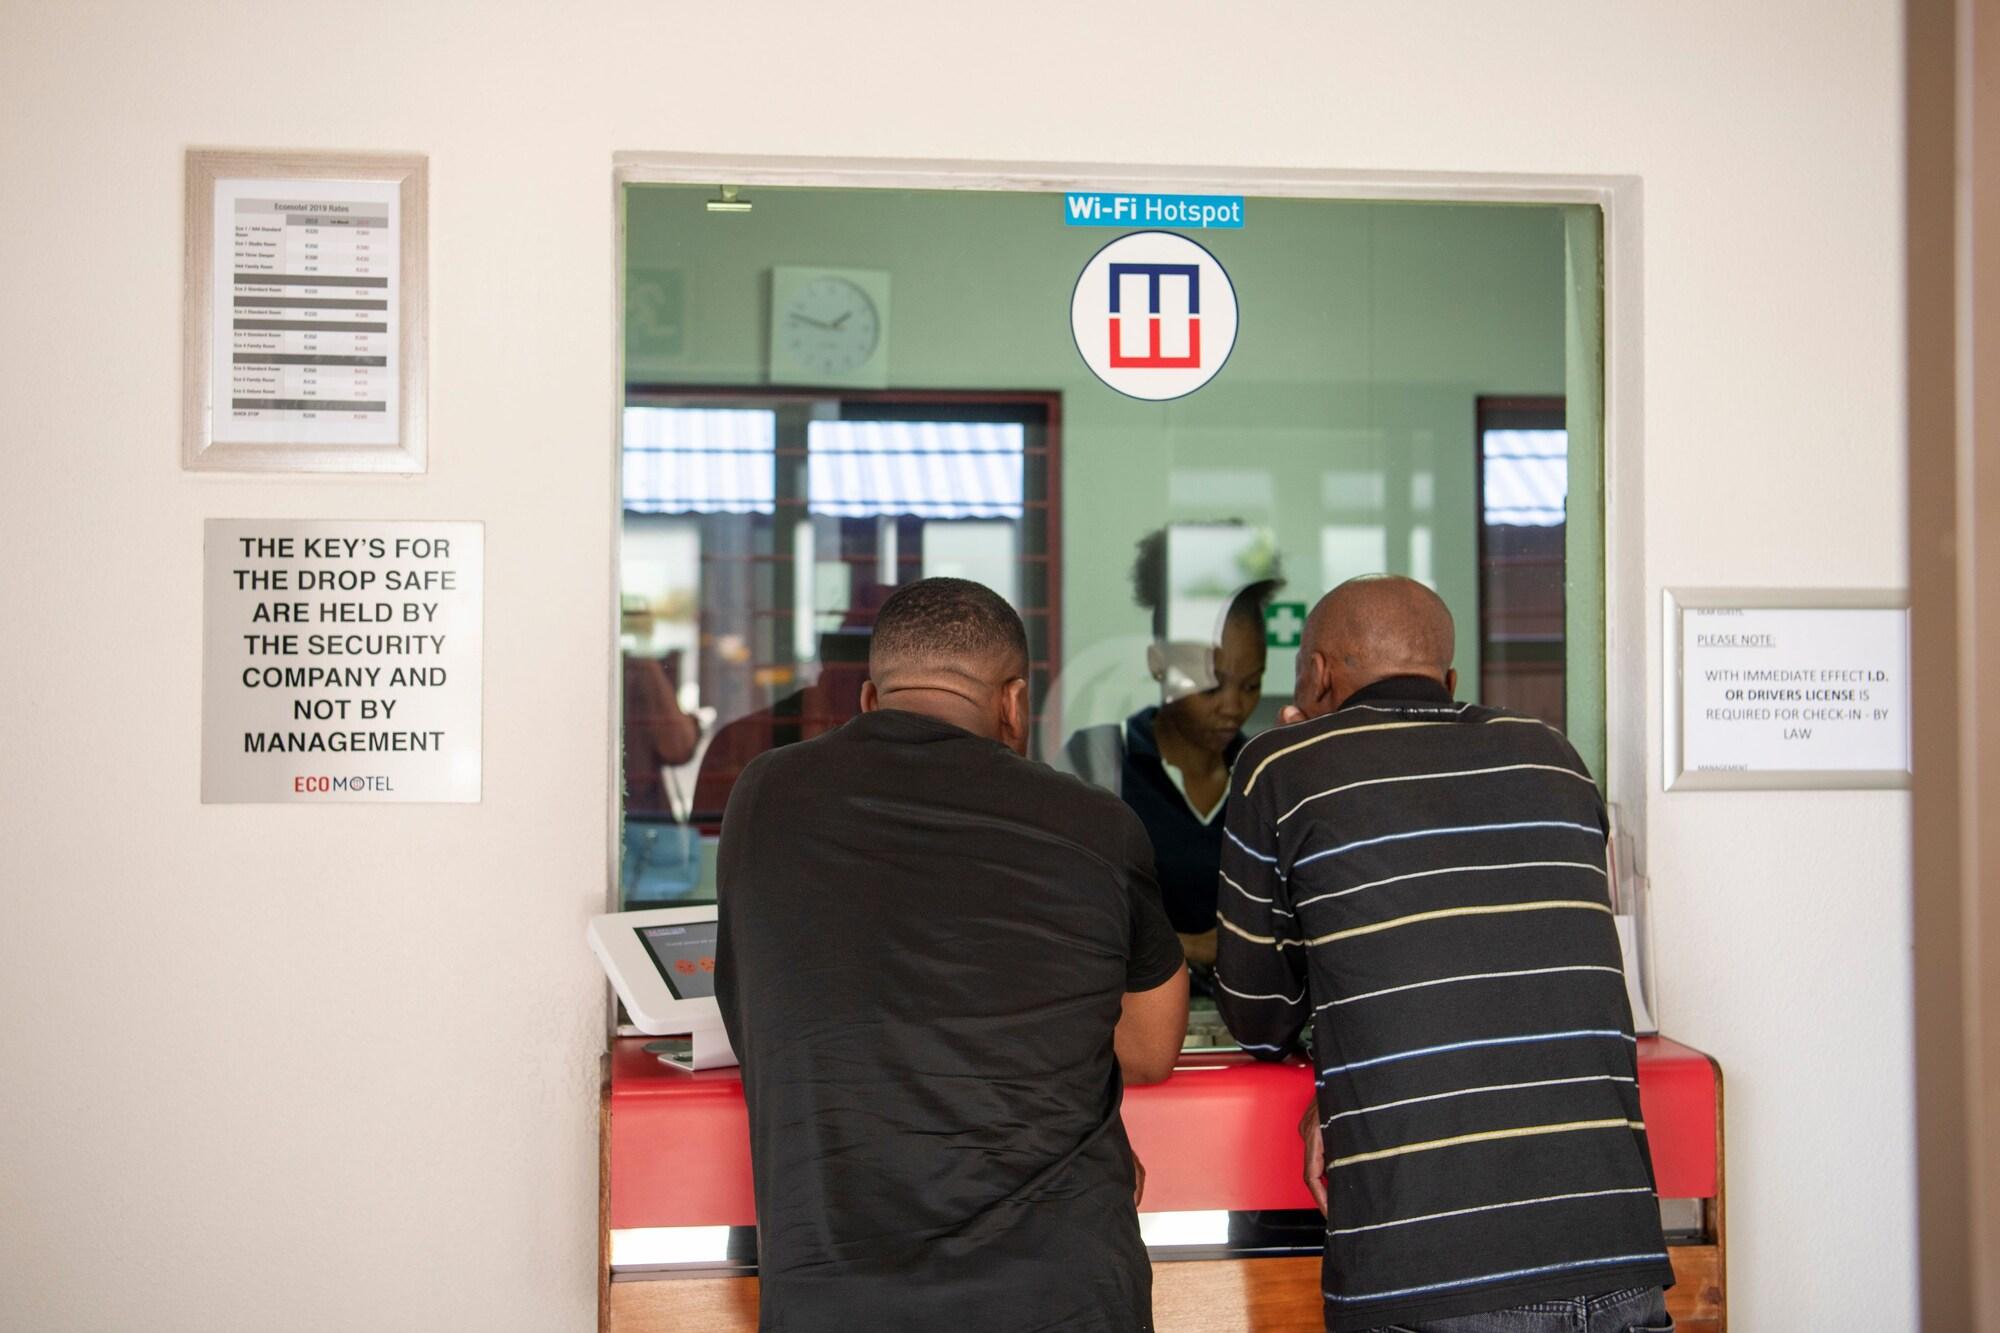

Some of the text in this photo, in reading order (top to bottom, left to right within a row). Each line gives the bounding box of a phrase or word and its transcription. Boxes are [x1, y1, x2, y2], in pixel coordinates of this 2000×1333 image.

[274, 202, 349, 213] Ecomotel 2019 Rates
[1068, 196, 1240, 228] Wi-Fi Hotspot
[239, 537, 451, 559] THE KEY'S FOR
[233, 570, 456, 591] THE DROP SAFE
[252, 602, 439, 623] ARE HELD BY
[243, 634, 446, 655] THE SECURITY
[1697, 634, 1776, 647] PLEASE NOTE:
[242, 667, 447, 688] COMPANY AND
[1705, 670, 1889, 682] WITH IMMEDIATE EFFECT I.D.
[1725, 689, 1870, 701] OR DRIVERS LICENSE IS
[293, 699, 396, 720] NOT BY
[1706, 708, 1771, 721] REQUIRED
[1775, 708, 1799, 720] FOR
[1802, 708, 1862, 720] CHECK-IN
[1873, 708, 1889, 720] BY
[244, 731, 445, 753] MANAGEMENT
[1783, 728, 1813, 740] LAW
